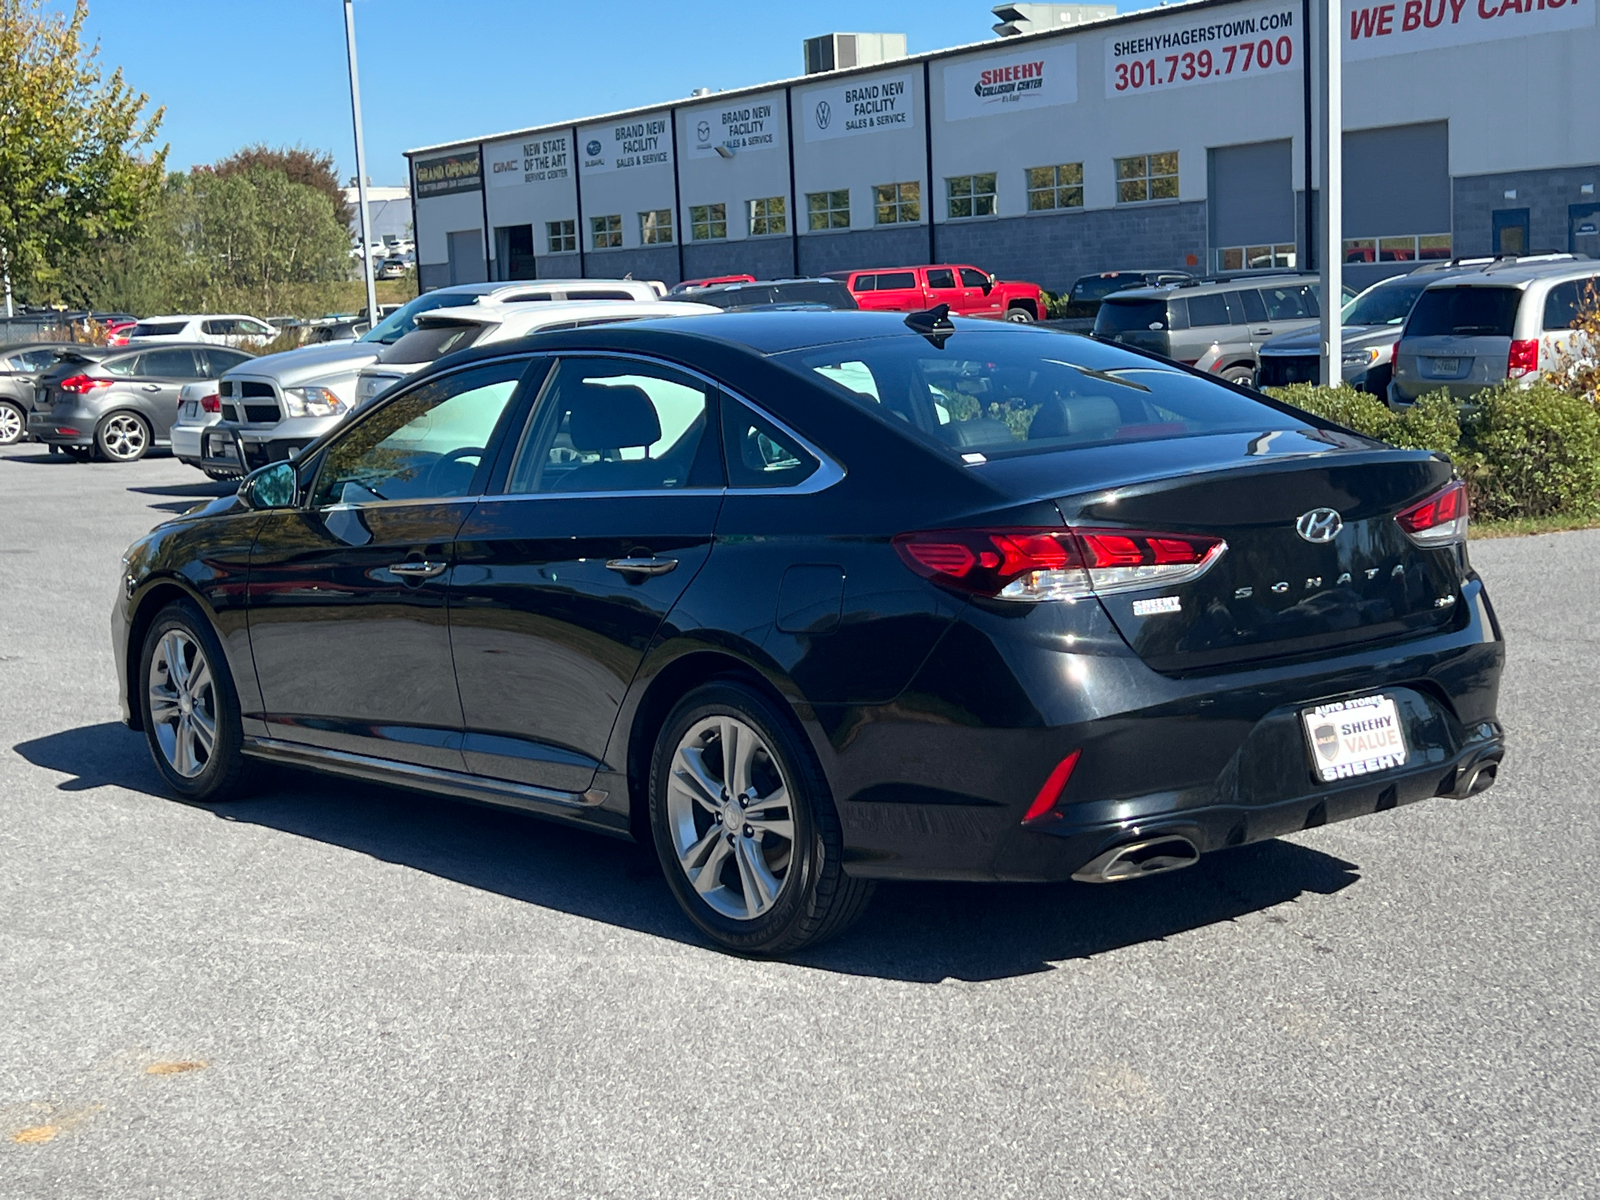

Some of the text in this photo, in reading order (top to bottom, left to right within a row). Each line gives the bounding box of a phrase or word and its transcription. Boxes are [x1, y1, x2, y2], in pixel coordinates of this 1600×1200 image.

[1350, 3, 1396, 40] WE
[1401, 0, 1466, 32] BUY
[1114, 12, 1293, 57] SHEEHYHAGERSTOWN.COM
[1114, 35, 1293, 91] 301.739.7700
[981, 61, 1044, 85] SHEEHY
[845, 81, 905, 104] BRAND NEW
[982, 78, 1043, 97] COLLISION CENTER
[721, 105, 772, 125] BRAND NEW
[854, 97, 896, 117] FACILITY
[615, 120, 666, 141] BRAND NEW
[729, 120, 764, 137] FACILITY
[845, 112, 906, 131] SALES & SERVICE
[524, 138, 566, 157] NEW STATE
[623, 136, 659, 154] FACILITY
[742, 138, 747, 147] &
[748, 134, 773, 146] SERVICE
[493, 160, 519, 174] GMC
[524, 153, 566, 172] OF THE ART
[616, 152, 668, 169] SALES & SERVICE
[417, 165, 444, 182] GRAND
[525, 168, 568, 183] SERVICE CENTER
[1234, 564, 1404, 600] SONATA
[1315, 702, 1344, 715] AUTO
[1341, 715, 1392, 736] SHEEHY
[1344, 729, 1399, 754] VALUE
[1322, 751, 1406, 782] SHEEHY
